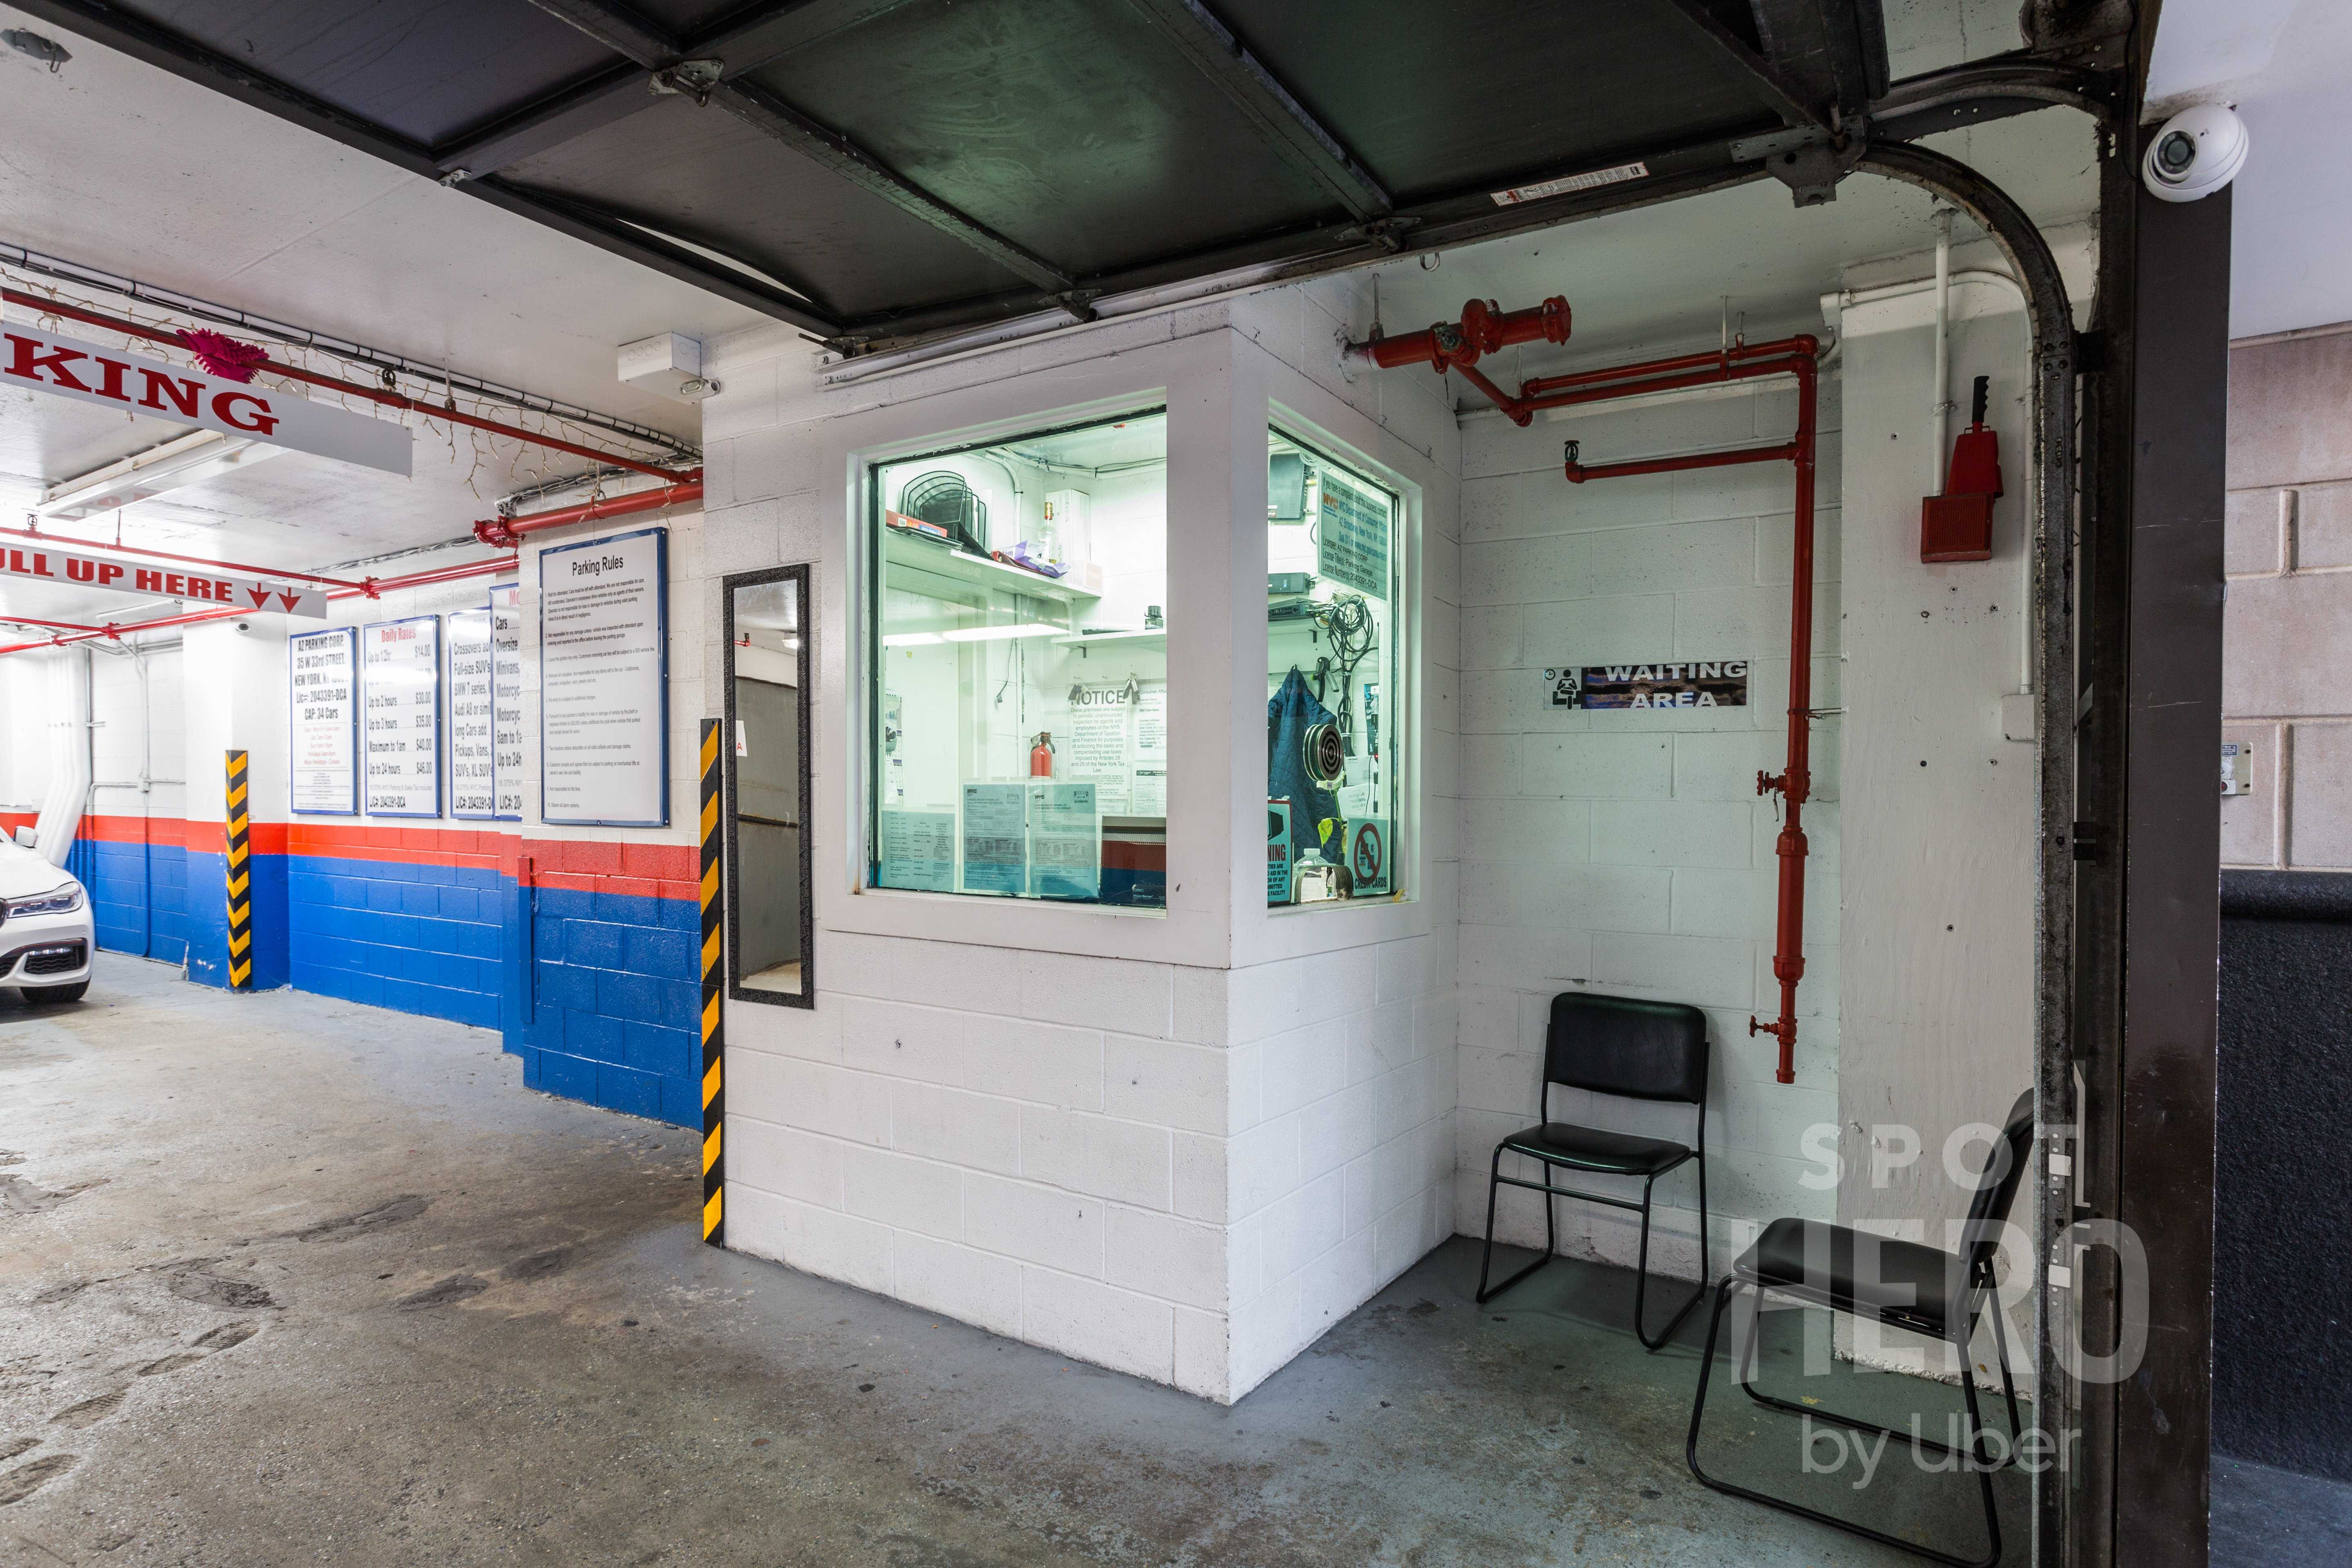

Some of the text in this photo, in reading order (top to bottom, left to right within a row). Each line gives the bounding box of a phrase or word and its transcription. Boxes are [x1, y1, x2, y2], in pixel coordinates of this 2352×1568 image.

[3, 333, 280, 436] KING
[1323, 492, 1339, 510] NYC
[1341, 488, 1354, 501] complaint
[1323, 535, 1337, 550] Licensee:
[1343, 547, 1358, 558] PARKING
[1359, 553, 1368, 562] CORP
[572, 555, 623, 576] Parking Rules
[1323, 548, 1373, 577] License Parking Garage
[0, 548, 232, 602] LL UP HERE
[1323, 560, 1377, 590] License 2043391-DCA
[496, 616, 508, 630] Cars
[381, 627, 416, 643] Daily Rates
[298, 635, 344, 652] AZ PARKING CORP.
[454, 642, 481, 655] Crossovers
[496, 637, 518, 653] Oversize
[415, 644, 430, 660] $14.00
[298, 657, 304, 669] 35
[305, 656, 310, 668] W
[312, 655, 324, 668] 33rd
[454, 660, 490, 676] Full-size SUV's
[496, 660, 520, 677] Minivans,
[295, 674, 306, 686] NEW
[1605, 662, 1746, 682] WAITING
[311, 688, 347, 703] 2043391-DCA
[454, 681, 487, 697] BMW series,
[369, 691, 431, 710] Up to 2 hours $30.00
[1630, 691, 1718, 708] AREA
[318, 707, 324, 719] 34
[326, 707, 339, 719] Cars
[455, 702, 479, 716] Audi A8 or
[369, 714, 431, 733] Up to 3 hours $35.00
[455, 722, 487, 740] long Cars add
[497, 729, 515, 744] 6am to
[369, 738, 432, 752] Maximum to 1am $40.00
[455, 743, 489, 760] Pickups, Vans,
[497, 752, 505, 771] Up
[506, 752, 511, 767] to
[369, 762, 432, 778] Up to 24 hours $46.00
[455, 764, 470, 780] SUV's,
[472, 764, 478, 777] XL
[498, 779, 514, 787] 18.375%
[380, 795, 406, 808] 2043391-DCA
[456, 796, 467, 810] LIC#:
[500, 794, 513, 811] LIC#:
[1354, 876, 1387, 889] CREDIT CARDS
